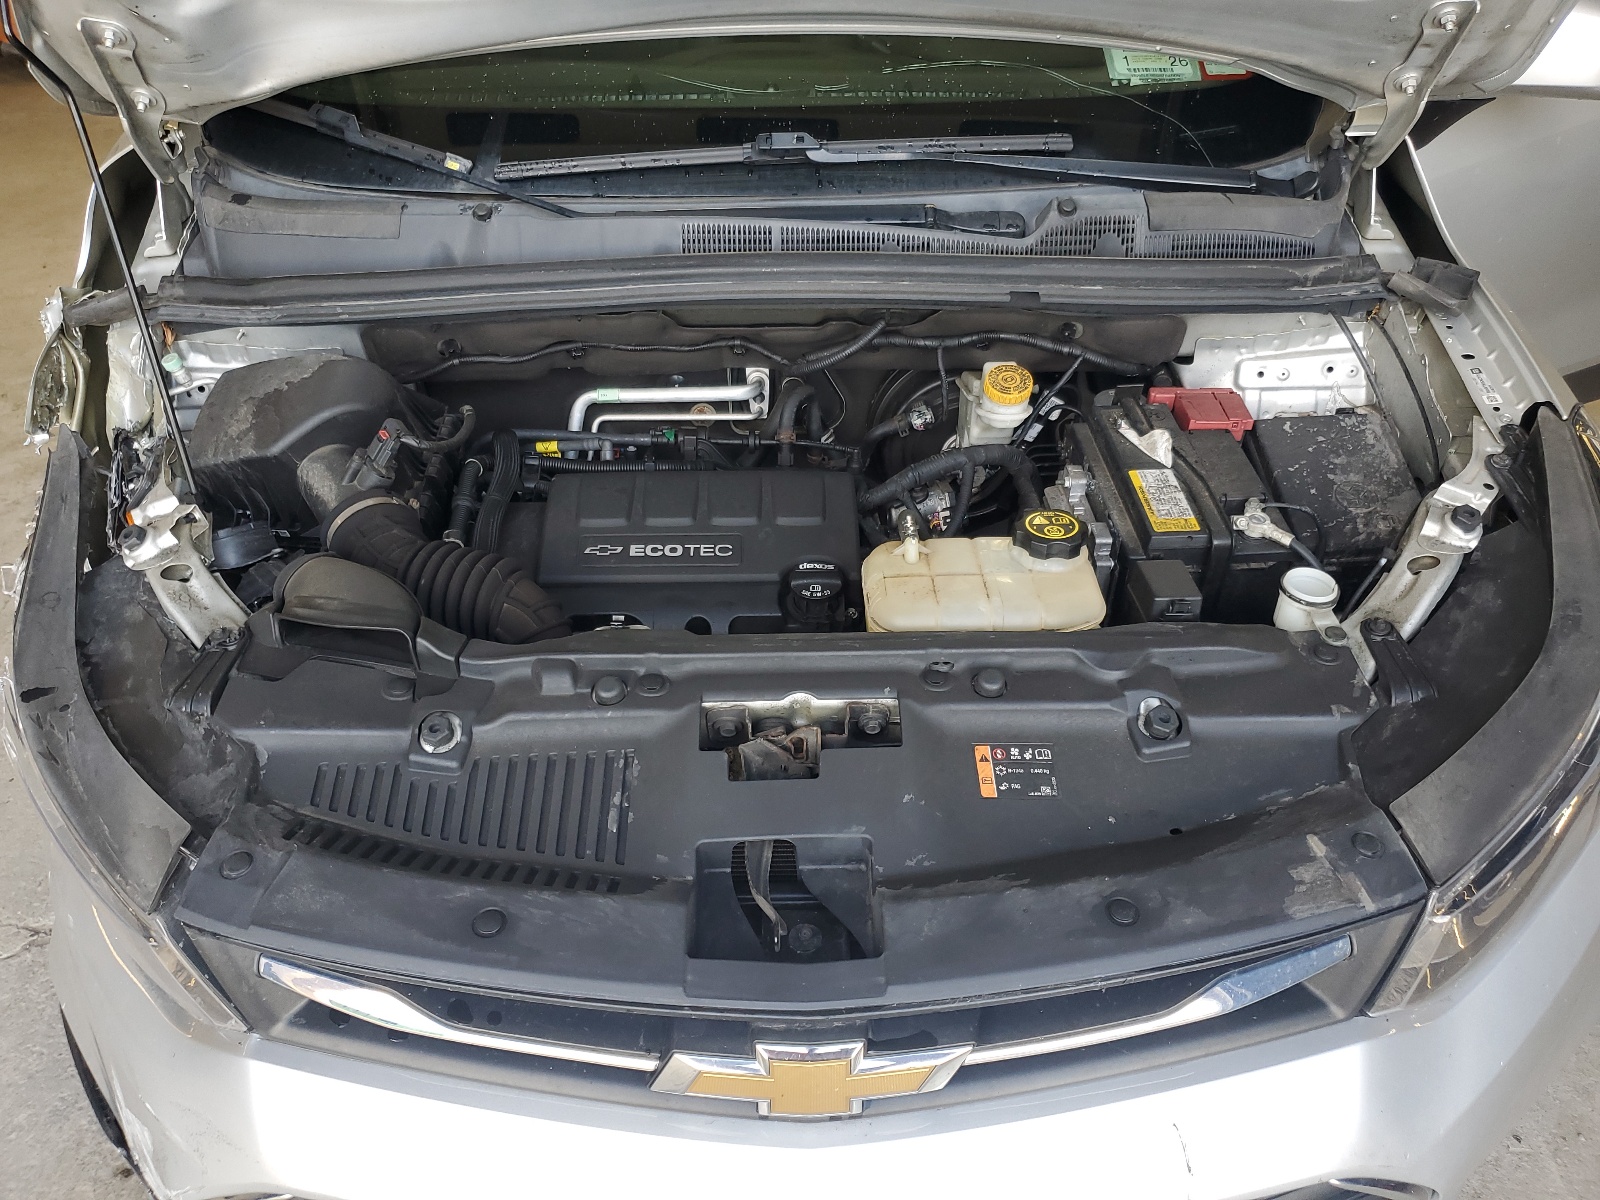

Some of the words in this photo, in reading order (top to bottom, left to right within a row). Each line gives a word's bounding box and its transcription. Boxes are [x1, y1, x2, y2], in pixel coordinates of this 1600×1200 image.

[1122, 55, 1130, 66] 1
[1168, 56, 1189, 67] 26
[629, 544, 733, 557] ECOTEC
[799, 562, 836, 570] dexos
